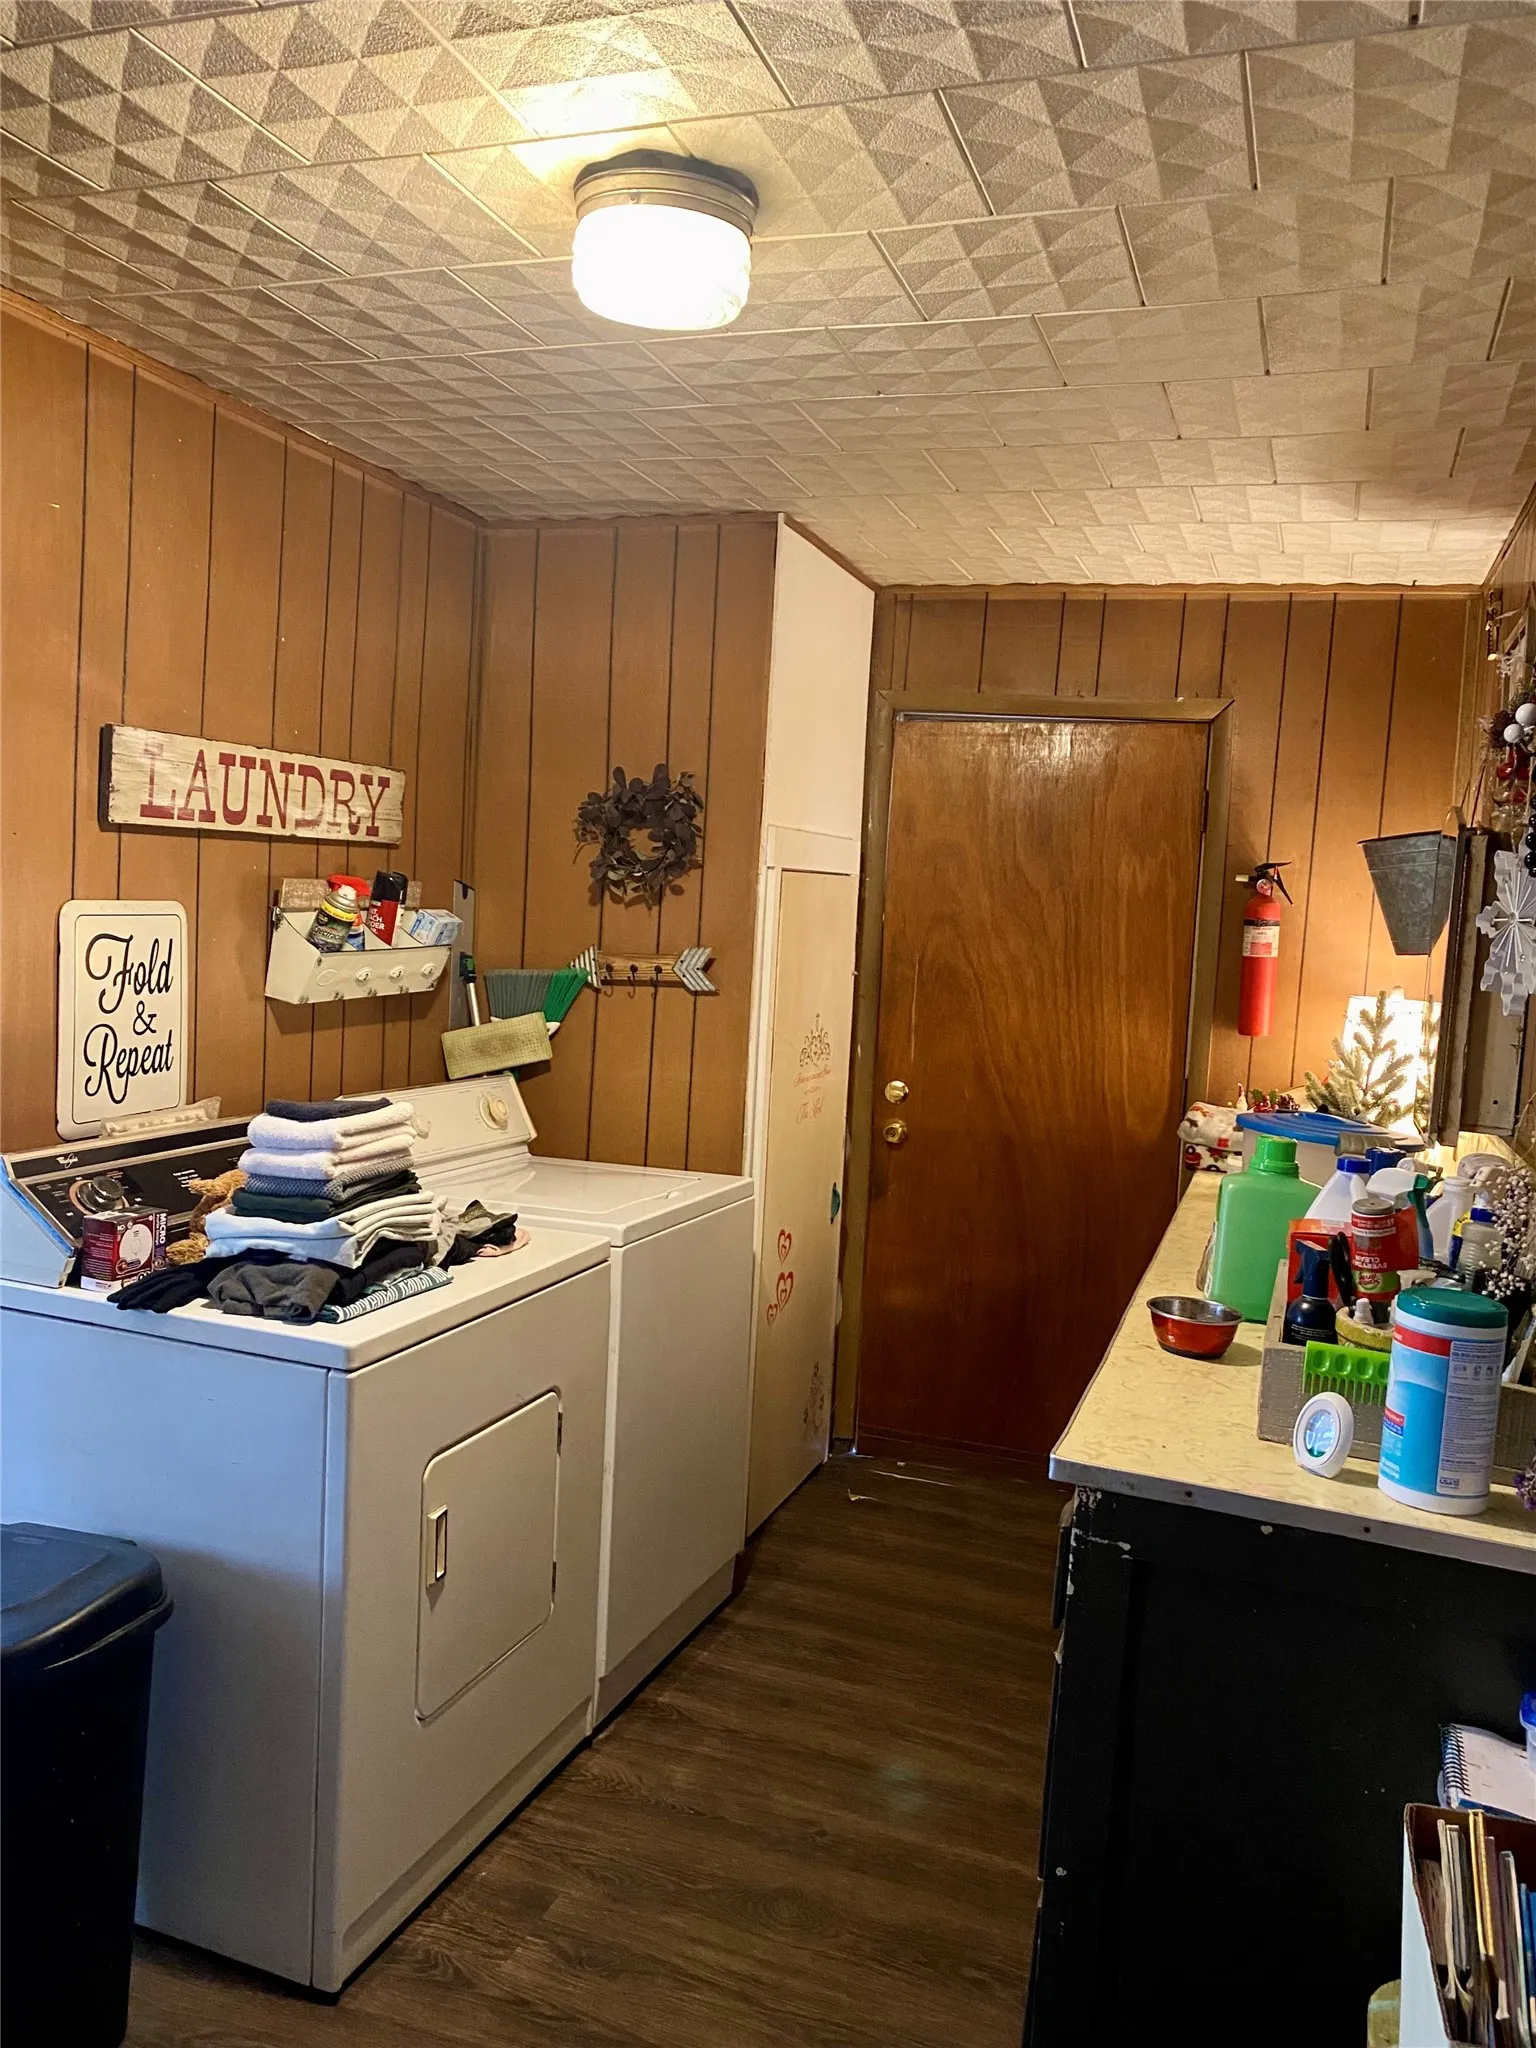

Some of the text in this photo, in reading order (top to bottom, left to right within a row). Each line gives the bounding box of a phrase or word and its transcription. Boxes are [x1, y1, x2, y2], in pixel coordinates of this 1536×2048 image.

[139, 742, 391, 837] LAUNDRY
[85, 933, 175, 1015] Fold
[132, 1000, 157, 1036] &
[83, 1023, 174, 1105] Repeat
[159, 1213, 167, 1244] MICRO
[1355, 1255, 1380, 1263] CLEAN
